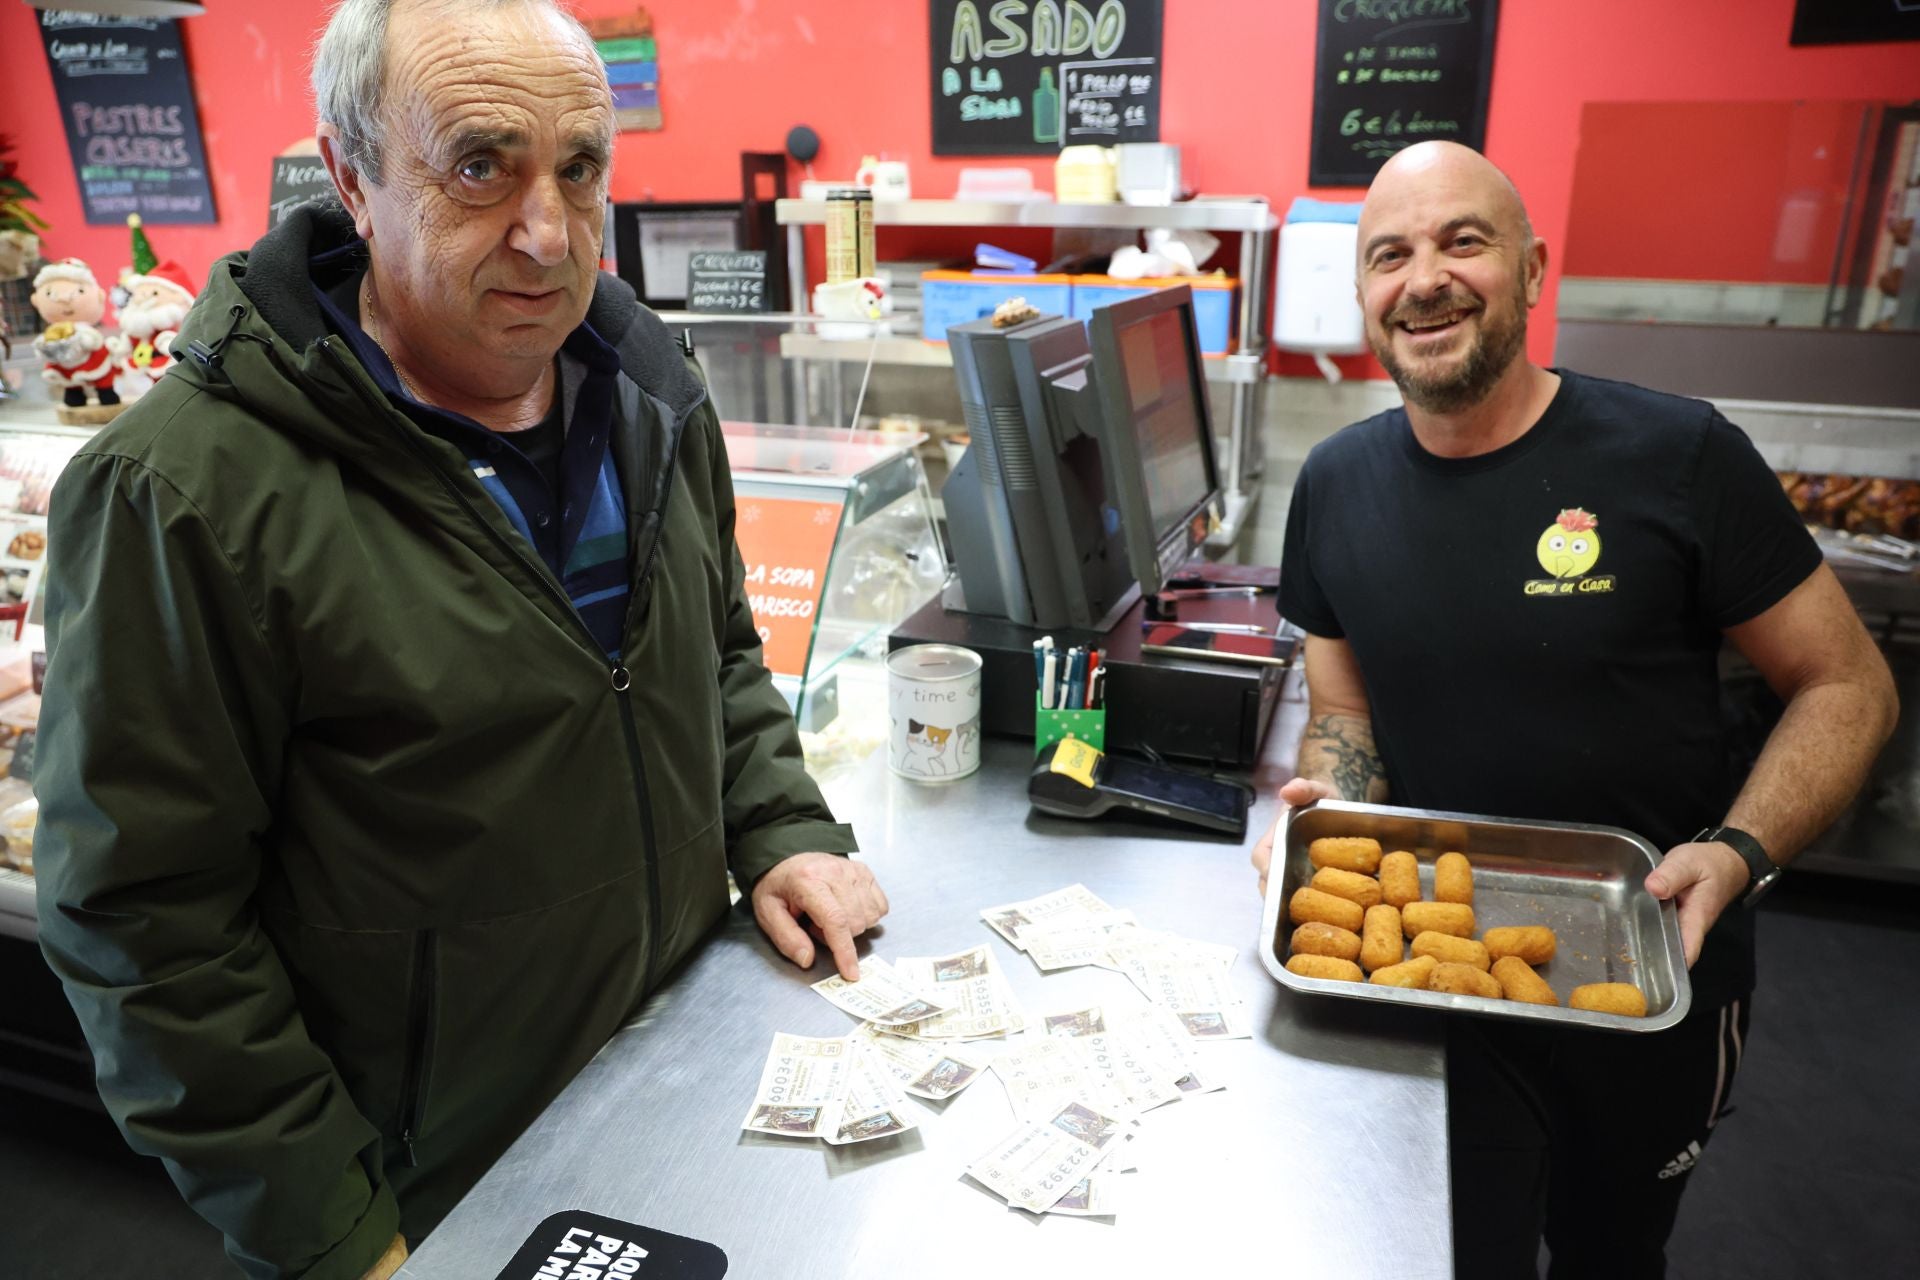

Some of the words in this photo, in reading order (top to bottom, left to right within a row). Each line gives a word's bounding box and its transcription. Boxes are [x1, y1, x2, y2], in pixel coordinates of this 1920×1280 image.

[951, 0, 1126, 63] ASADO
[942, 67, 961, 96] A
[970, 66, 1002, 92] LA
[769, 566, 815, 590] SOPA
[1524, 581, 1557, 595] Como
[1560, 582, 1575, 593] en
[1578, 578, 1611, 593] Casa
[912, 687, 956, 703] time
[769, 1056, 793, 1103] 60034
[1039, 1147, 1090, 1190] 22392
[553, 1227, 594, 1254] LA
